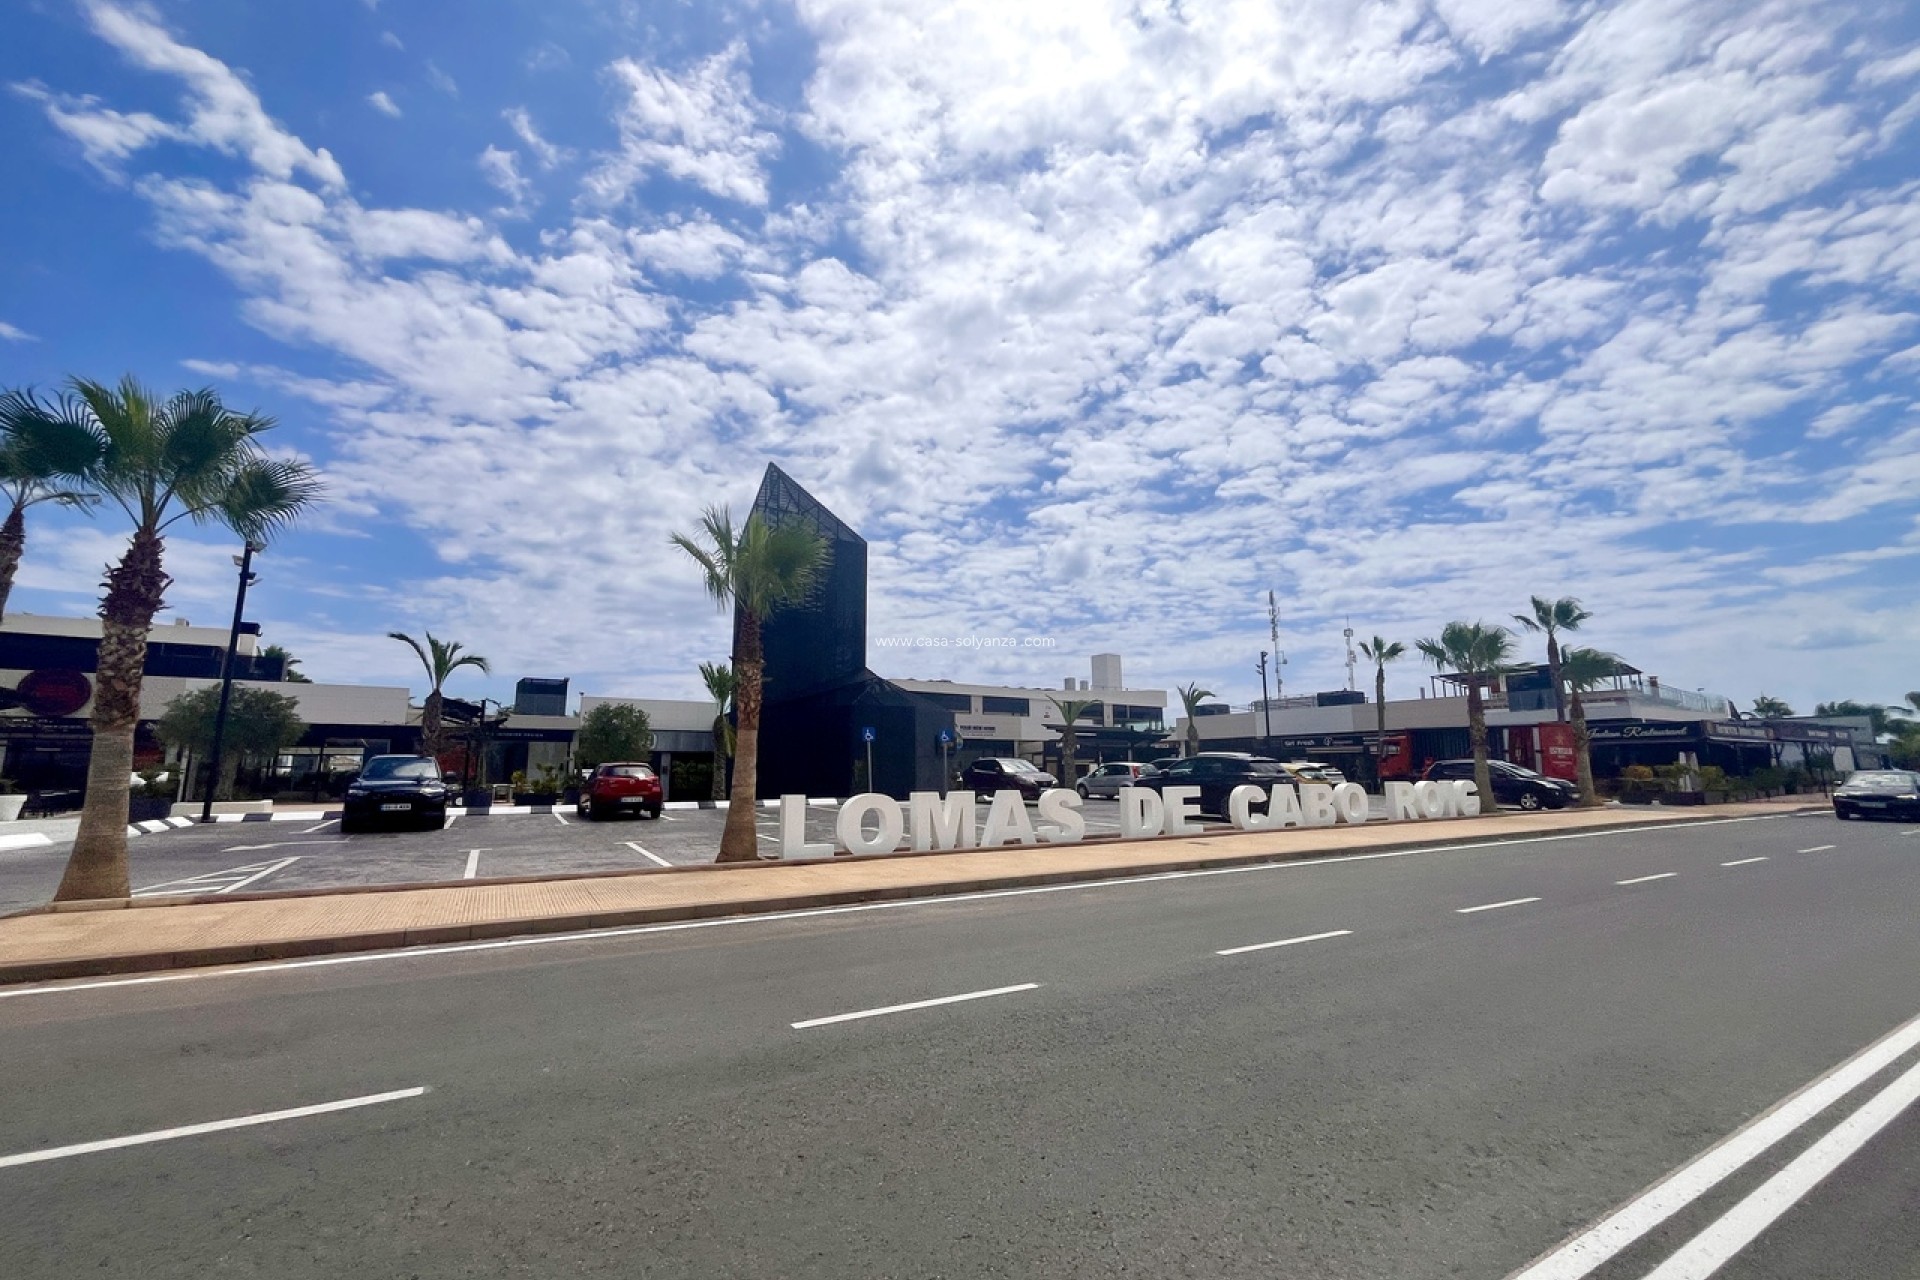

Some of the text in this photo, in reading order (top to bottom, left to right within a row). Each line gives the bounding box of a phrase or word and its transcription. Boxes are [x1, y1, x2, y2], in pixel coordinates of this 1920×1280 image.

[779, 780, 1480, 861] LOMAS DE CABO ROIG
